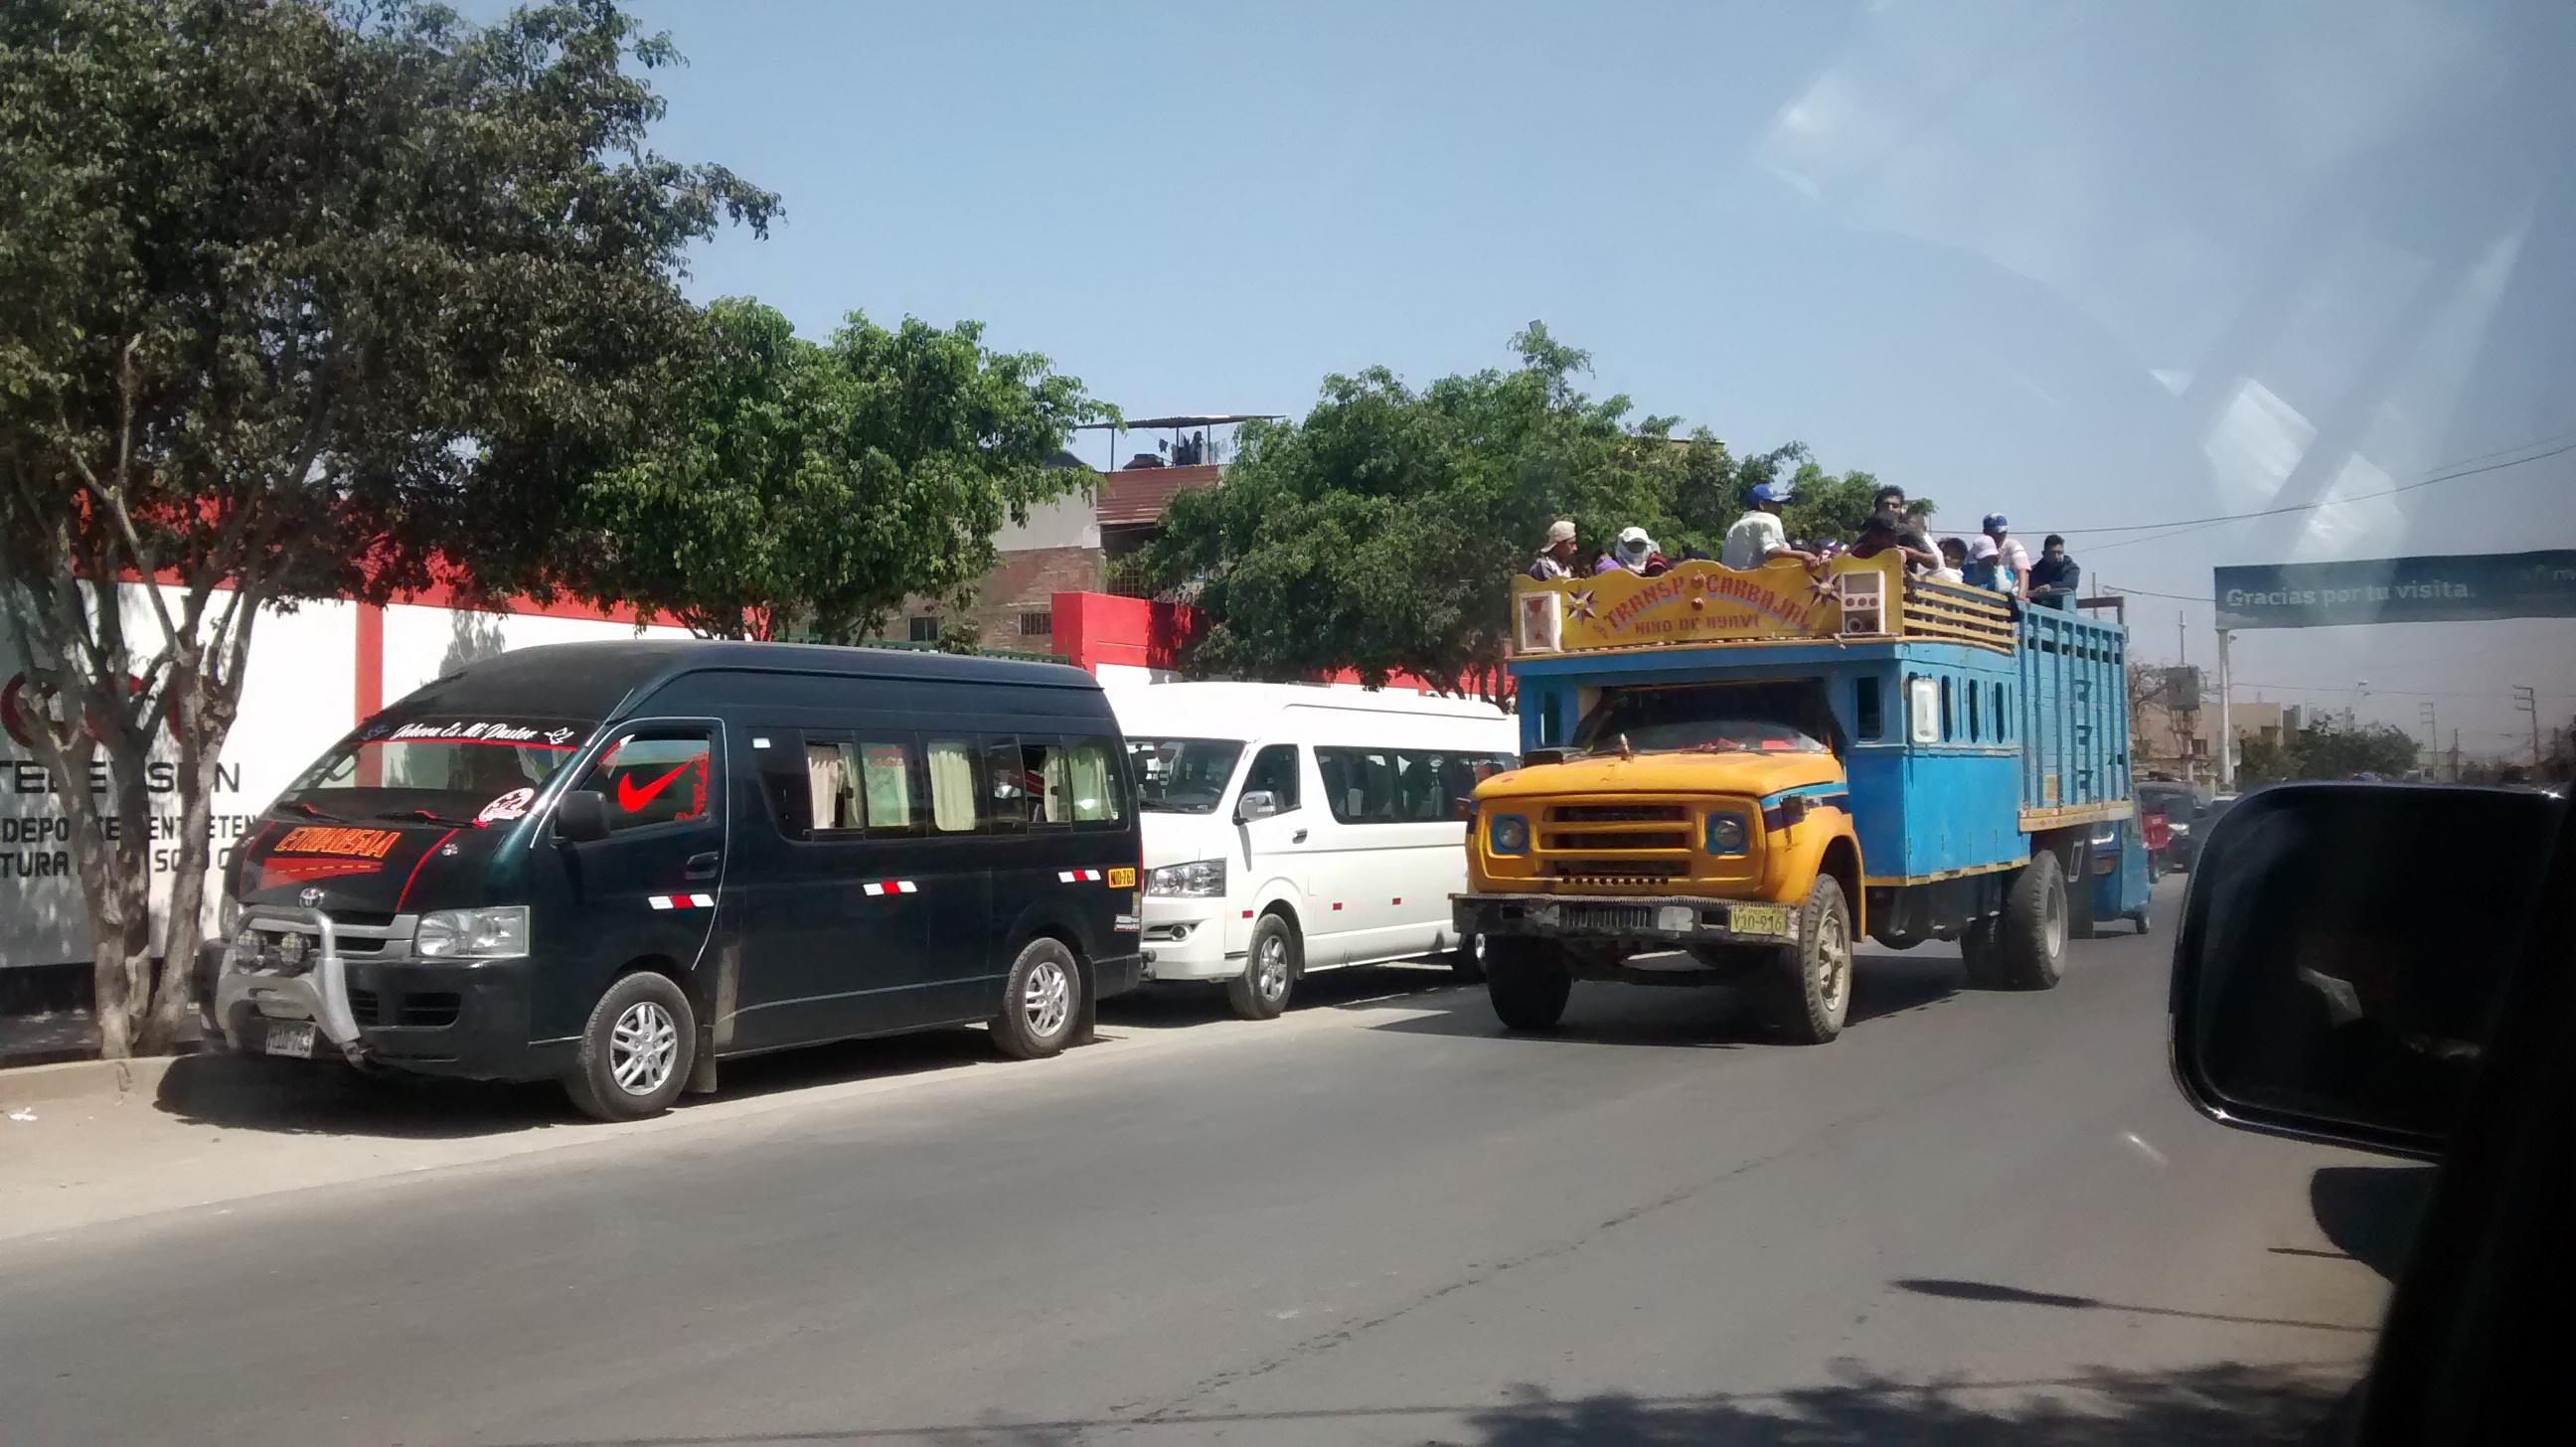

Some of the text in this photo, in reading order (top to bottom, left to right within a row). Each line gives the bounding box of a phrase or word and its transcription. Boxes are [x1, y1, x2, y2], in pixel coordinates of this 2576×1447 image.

[2226, 587, 2317, 607] Gracias
[2323, 586, 2362, 609] por
[2366, 583, 2391, 601] tu
